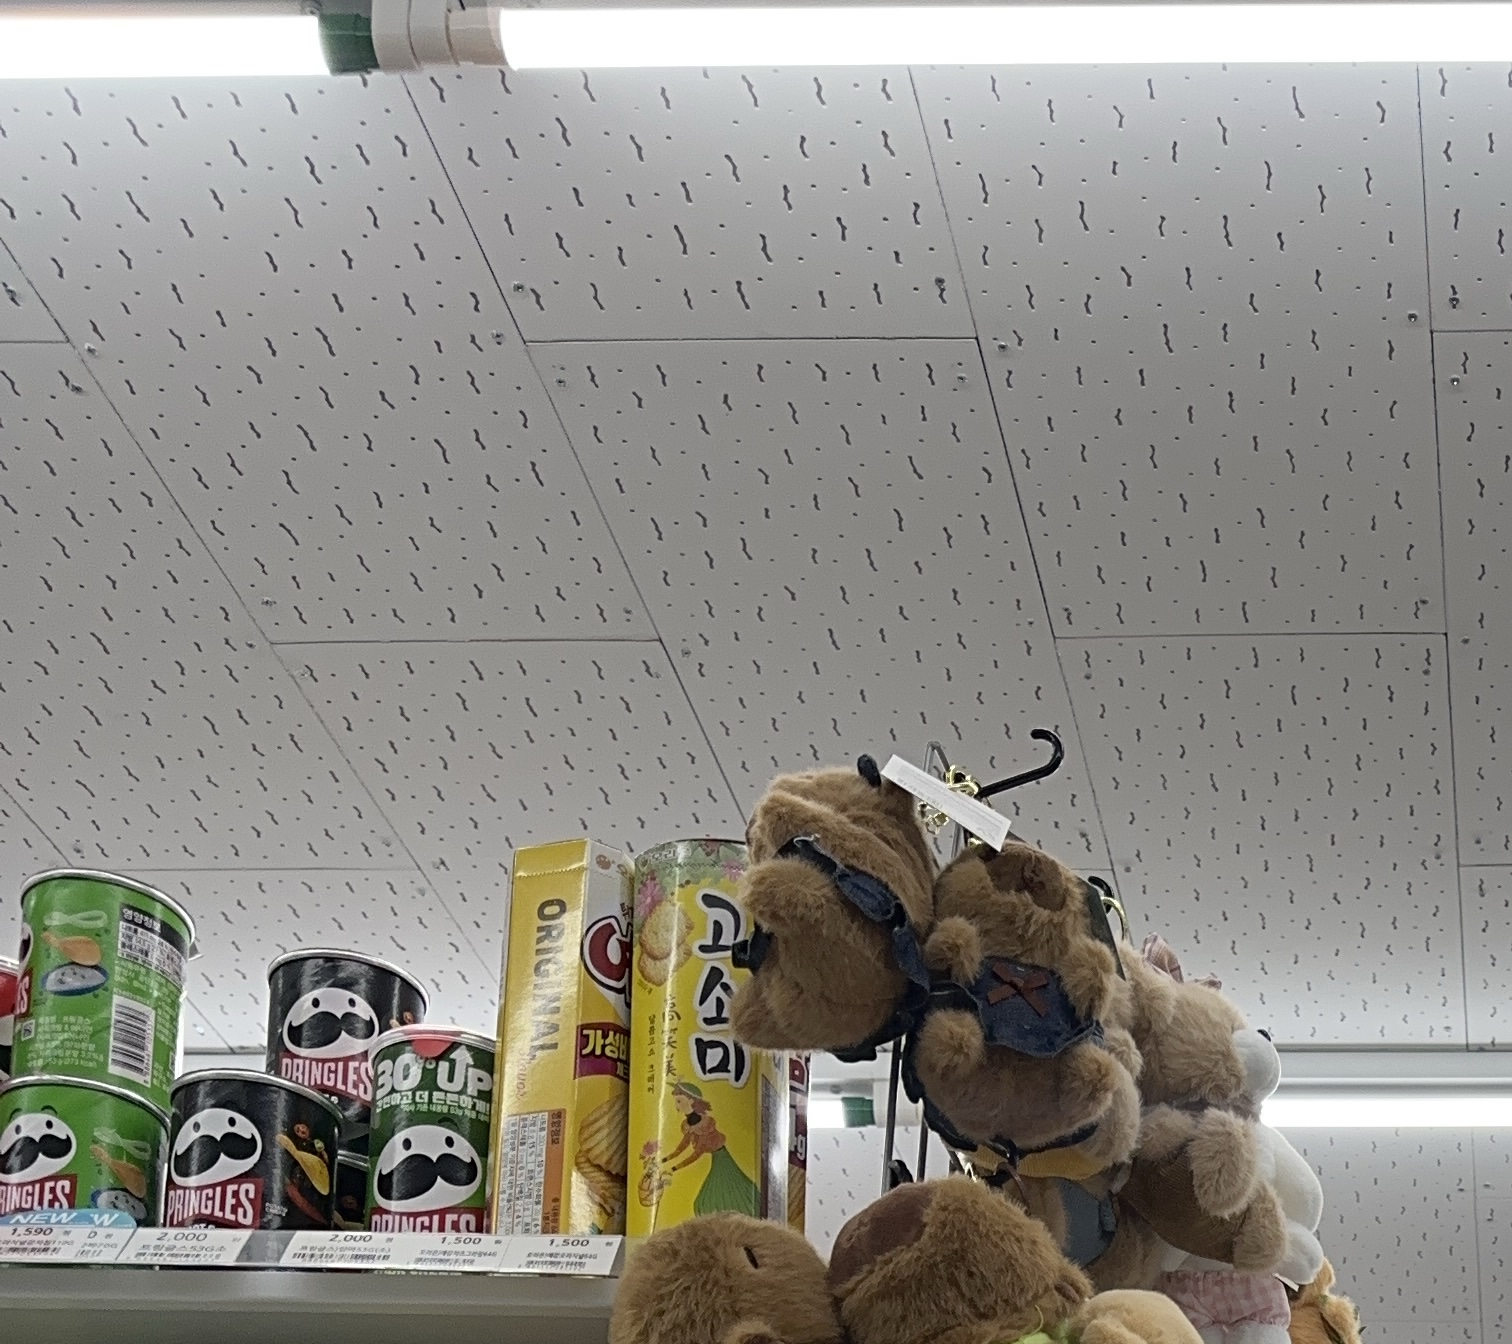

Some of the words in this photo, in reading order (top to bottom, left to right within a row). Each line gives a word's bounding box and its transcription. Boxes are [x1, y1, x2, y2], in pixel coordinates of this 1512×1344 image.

[530, 897, 567, 1052] ORIGINAL
[695, 892, 746, 1083] 고소미
[281, 1057, 374, 1101] PRINGLES
[0, 1178, 71, 1218] RINGLES
[168, 1181, 256, 1226] PRINGLES
[11, 1226, 54, 1238] 1,590
[156, 1231, 208, 1242] 2,000
[329, 1234, 373, 1244] 2,000
[441, 1236, 483, 1246] 1,500
[549, 1238, 590, 1248] 1,500
